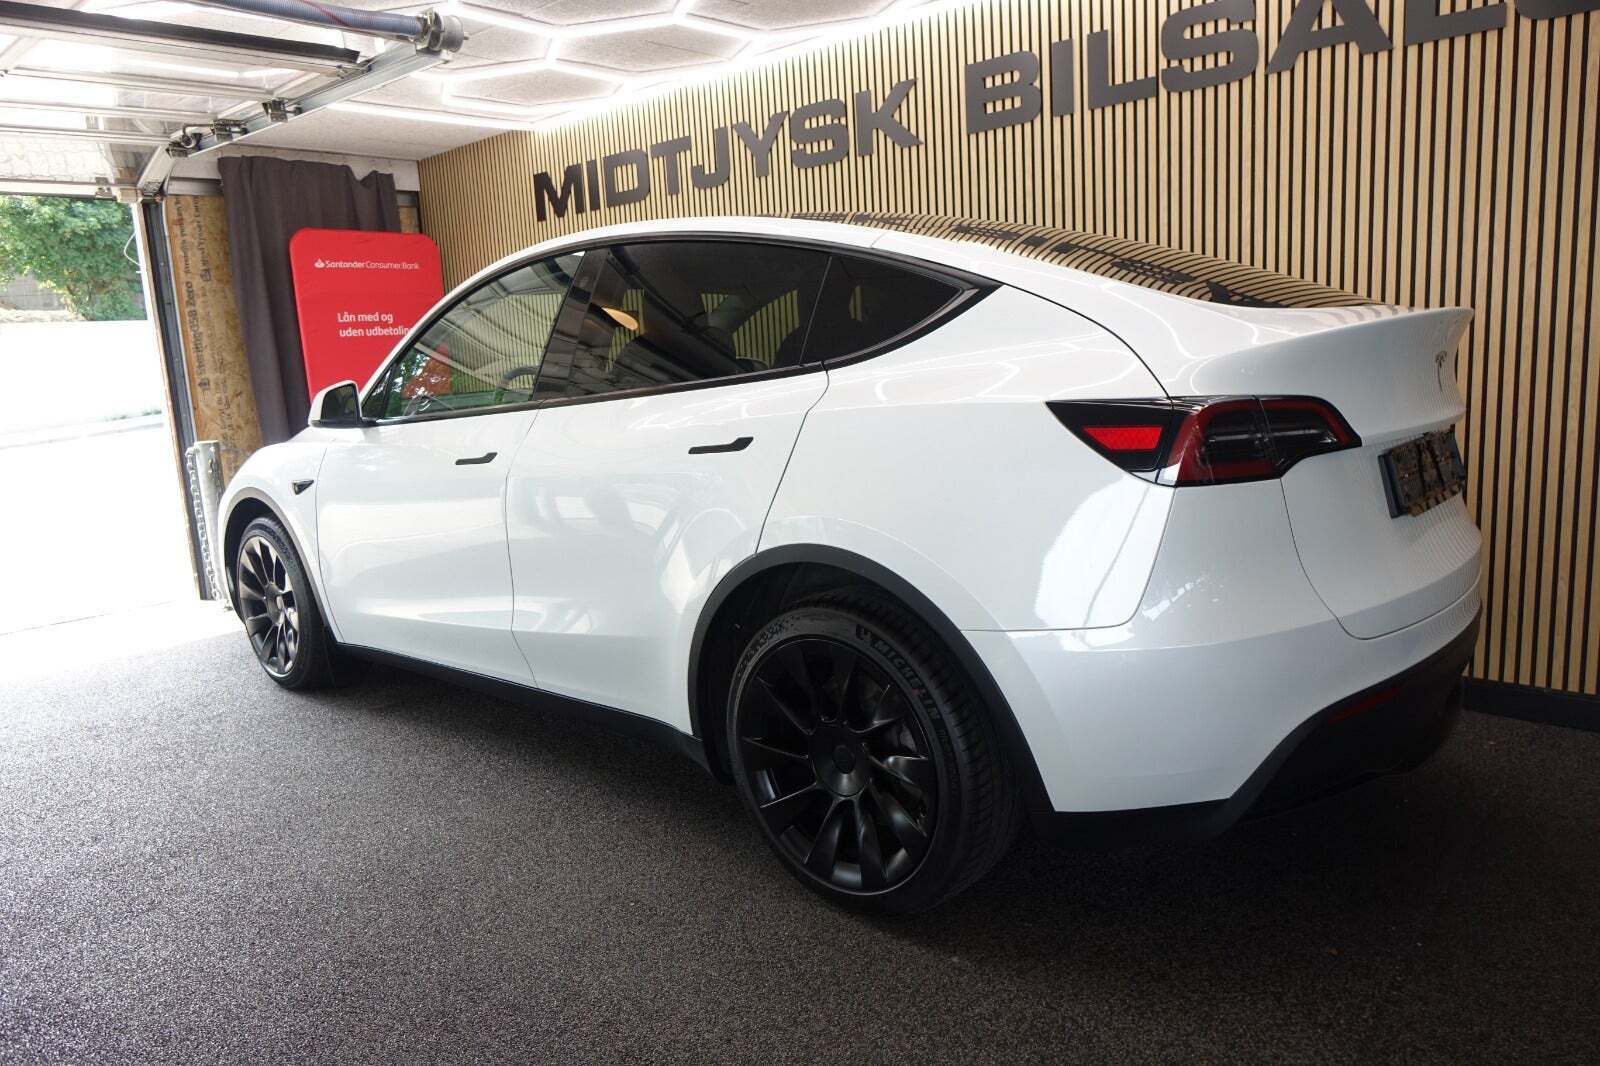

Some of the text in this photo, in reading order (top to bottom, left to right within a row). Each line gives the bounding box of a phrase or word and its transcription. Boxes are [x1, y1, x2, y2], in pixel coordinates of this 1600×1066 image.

[533, 0, 1600, 222] MIDTJYSK BILSAL
[185, 280, 197, 307] Zero
[337, 311, 393, 324] Lån med og
[339, 325, 411, 337] uden udbetalin
